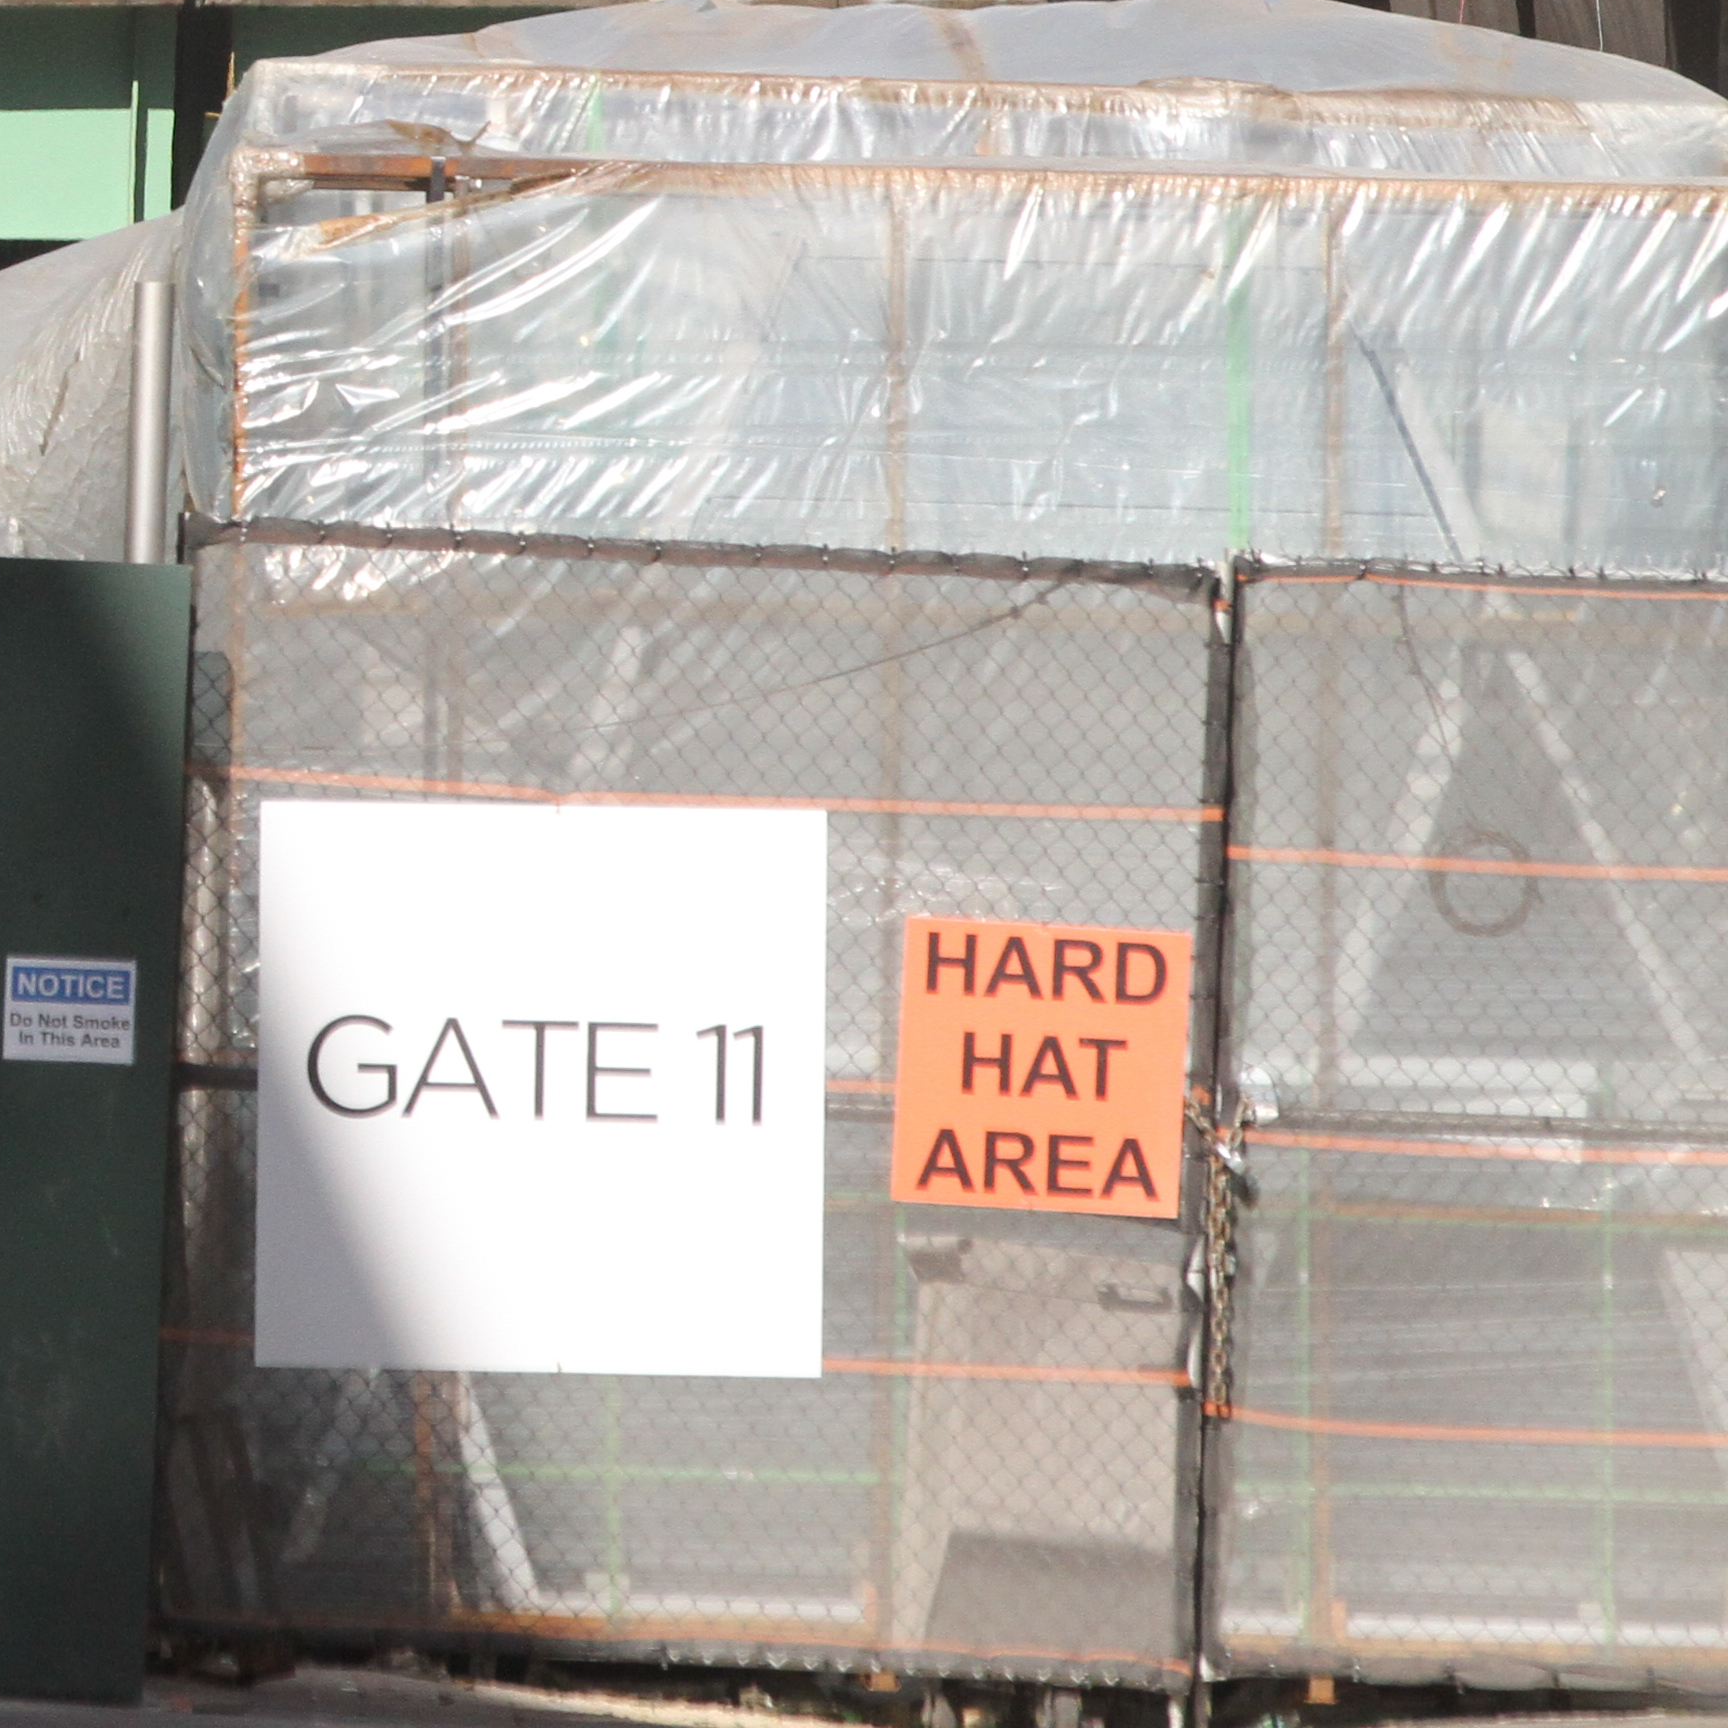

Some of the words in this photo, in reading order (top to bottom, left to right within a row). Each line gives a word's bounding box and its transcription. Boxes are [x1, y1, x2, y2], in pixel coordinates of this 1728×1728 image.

[17, 973, 125, 999] NOTICE
[926, 932, 1168, 1006] HARD
[10, 1012, 33, 1027] Do
[38, 1013, 67, 1029] Not
[73, 1015, 131, 1031] Smoke
[19, 1031, 34, 1045] In
[41, 1032, 75, 1046] This
[81, 1033, 120, 1048] Area
[307, 1014, 659, 1124] GATE
[696, 1024, 764, 1126] 11
[961, 1031, 1128, 1101] HAT
[915, 1128, 1162, 1203] AREA
